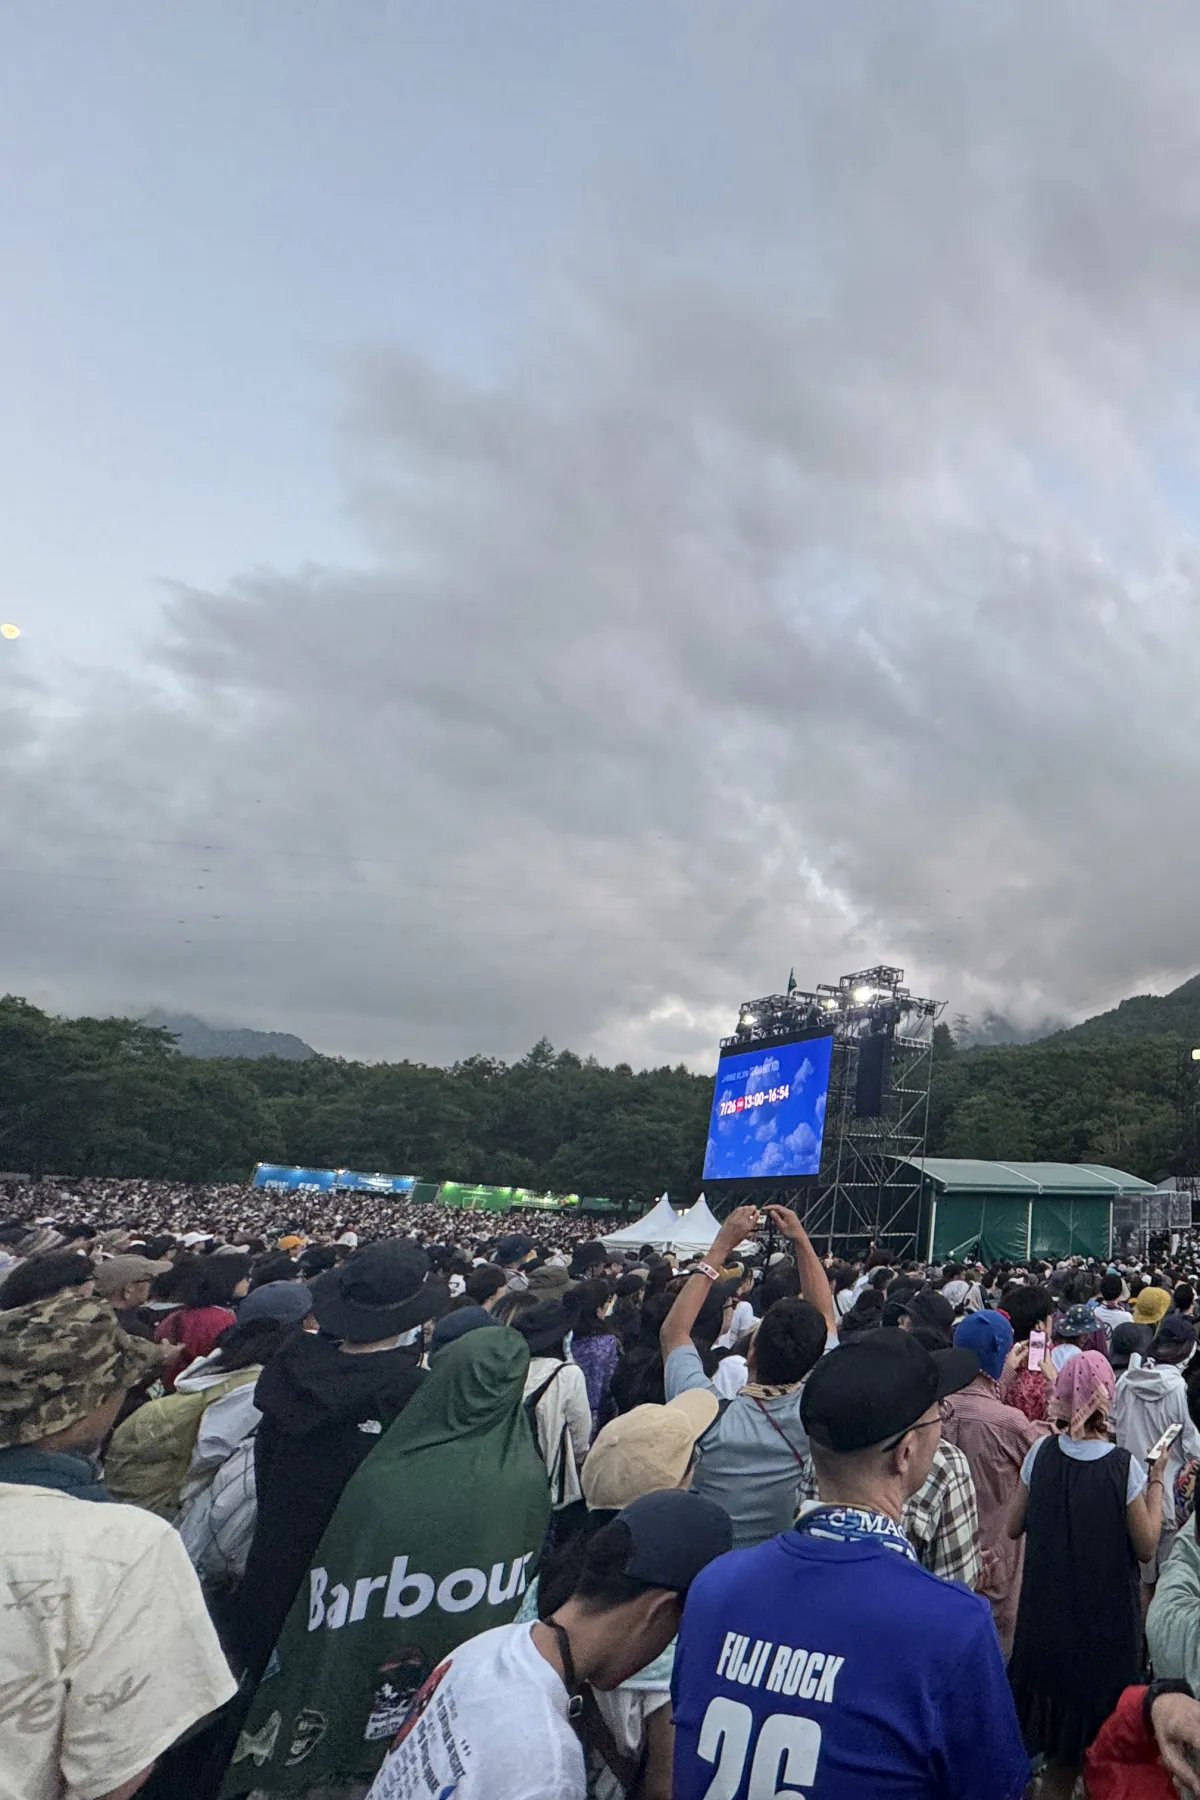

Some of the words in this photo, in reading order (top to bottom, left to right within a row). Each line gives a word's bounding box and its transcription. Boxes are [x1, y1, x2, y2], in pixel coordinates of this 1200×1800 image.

[720, 1101, 736, 1116] 7/26
[308, 1551, 534, 1632] Barbour
[716, 1631, 773, 1688] FUJI
[765, 1645, 845, 1703] ROCK
[697, 1696, 822, 1800] 26
